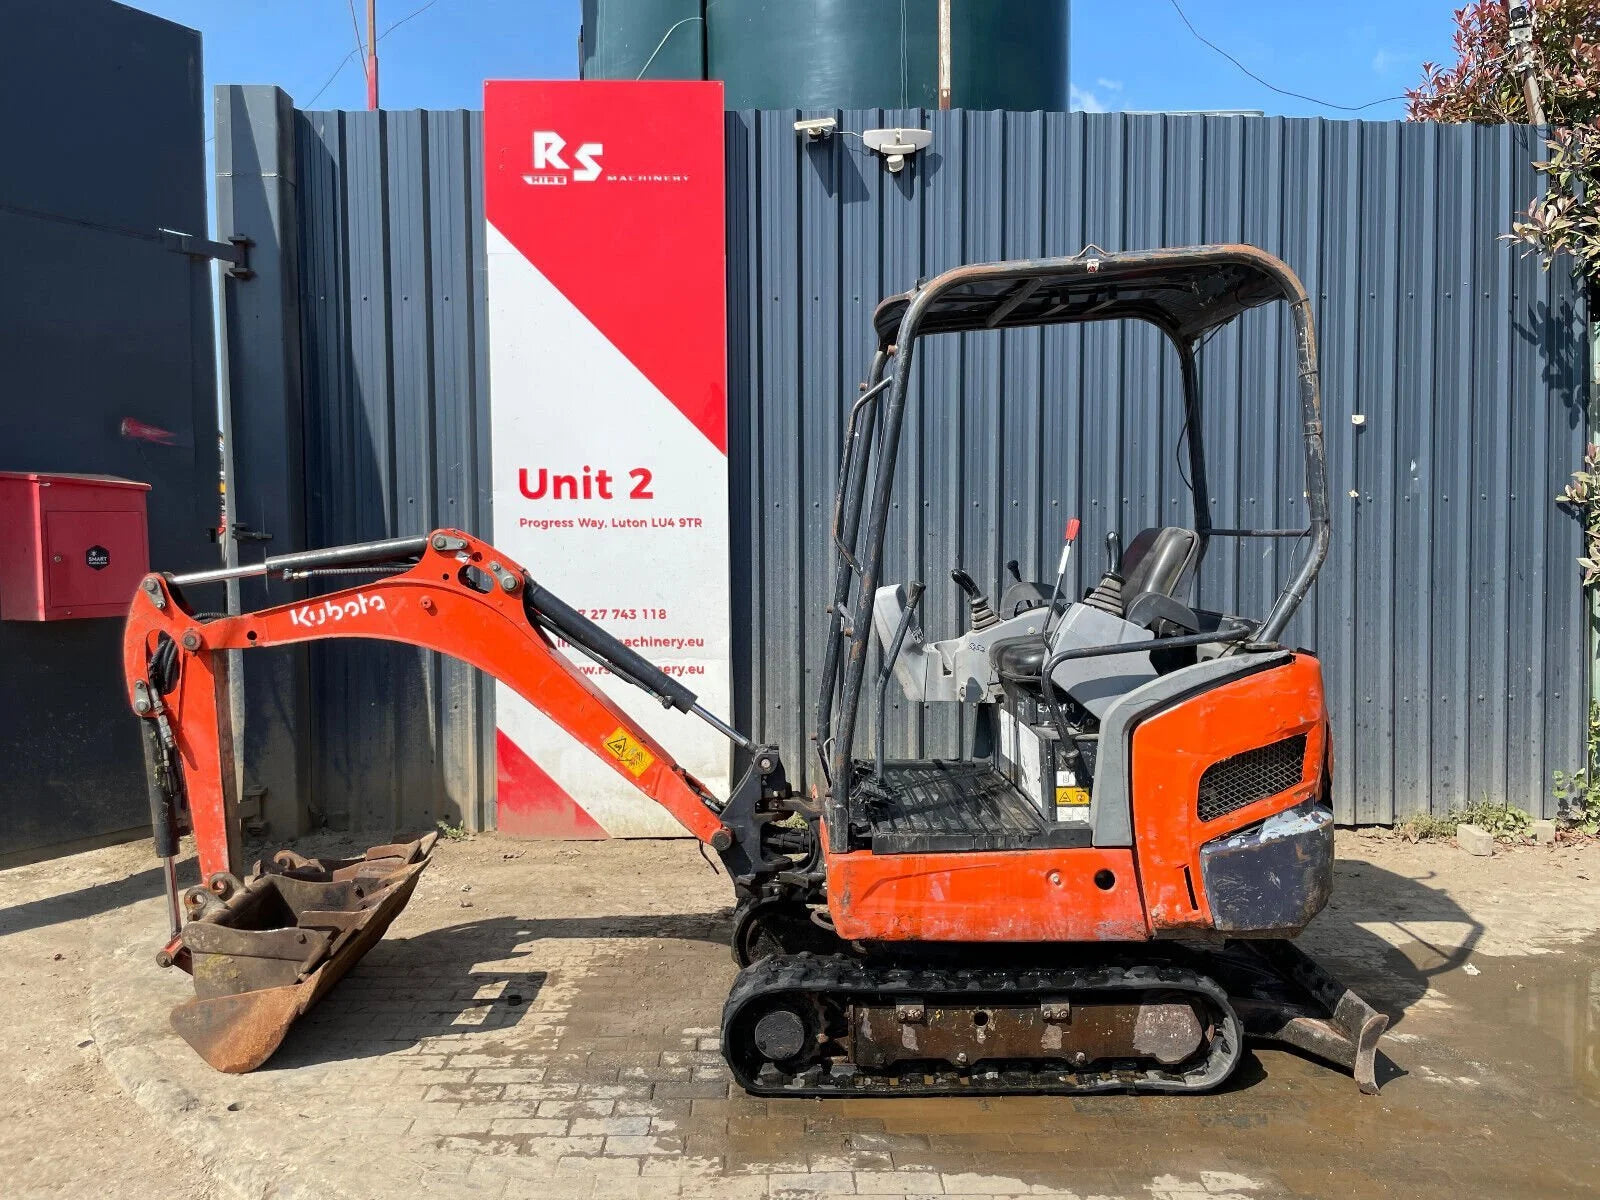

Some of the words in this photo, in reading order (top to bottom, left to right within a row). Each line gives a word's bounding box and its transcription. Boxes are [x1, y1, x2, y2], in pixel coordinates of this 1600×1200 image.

[533, 131, 603, 181] RS
[530, 175, 566, 184] HIRE
[518, 465, 613, 500] Unit
[628, 467, 654, 500] 2
[519, 517, 574, 530] Progress
[578, 517, 608, 530] Way,
[612, 517, 648, 529] Luton
[651, 517, 676, 529] LU4
[679, 517, 703, 529] 9TR
[289, 593, 385, 627] Kubota
[590, 608, 607, 620] 27
[612, 608, 637, 620] 743
[643, 608, 667, 620] 118
